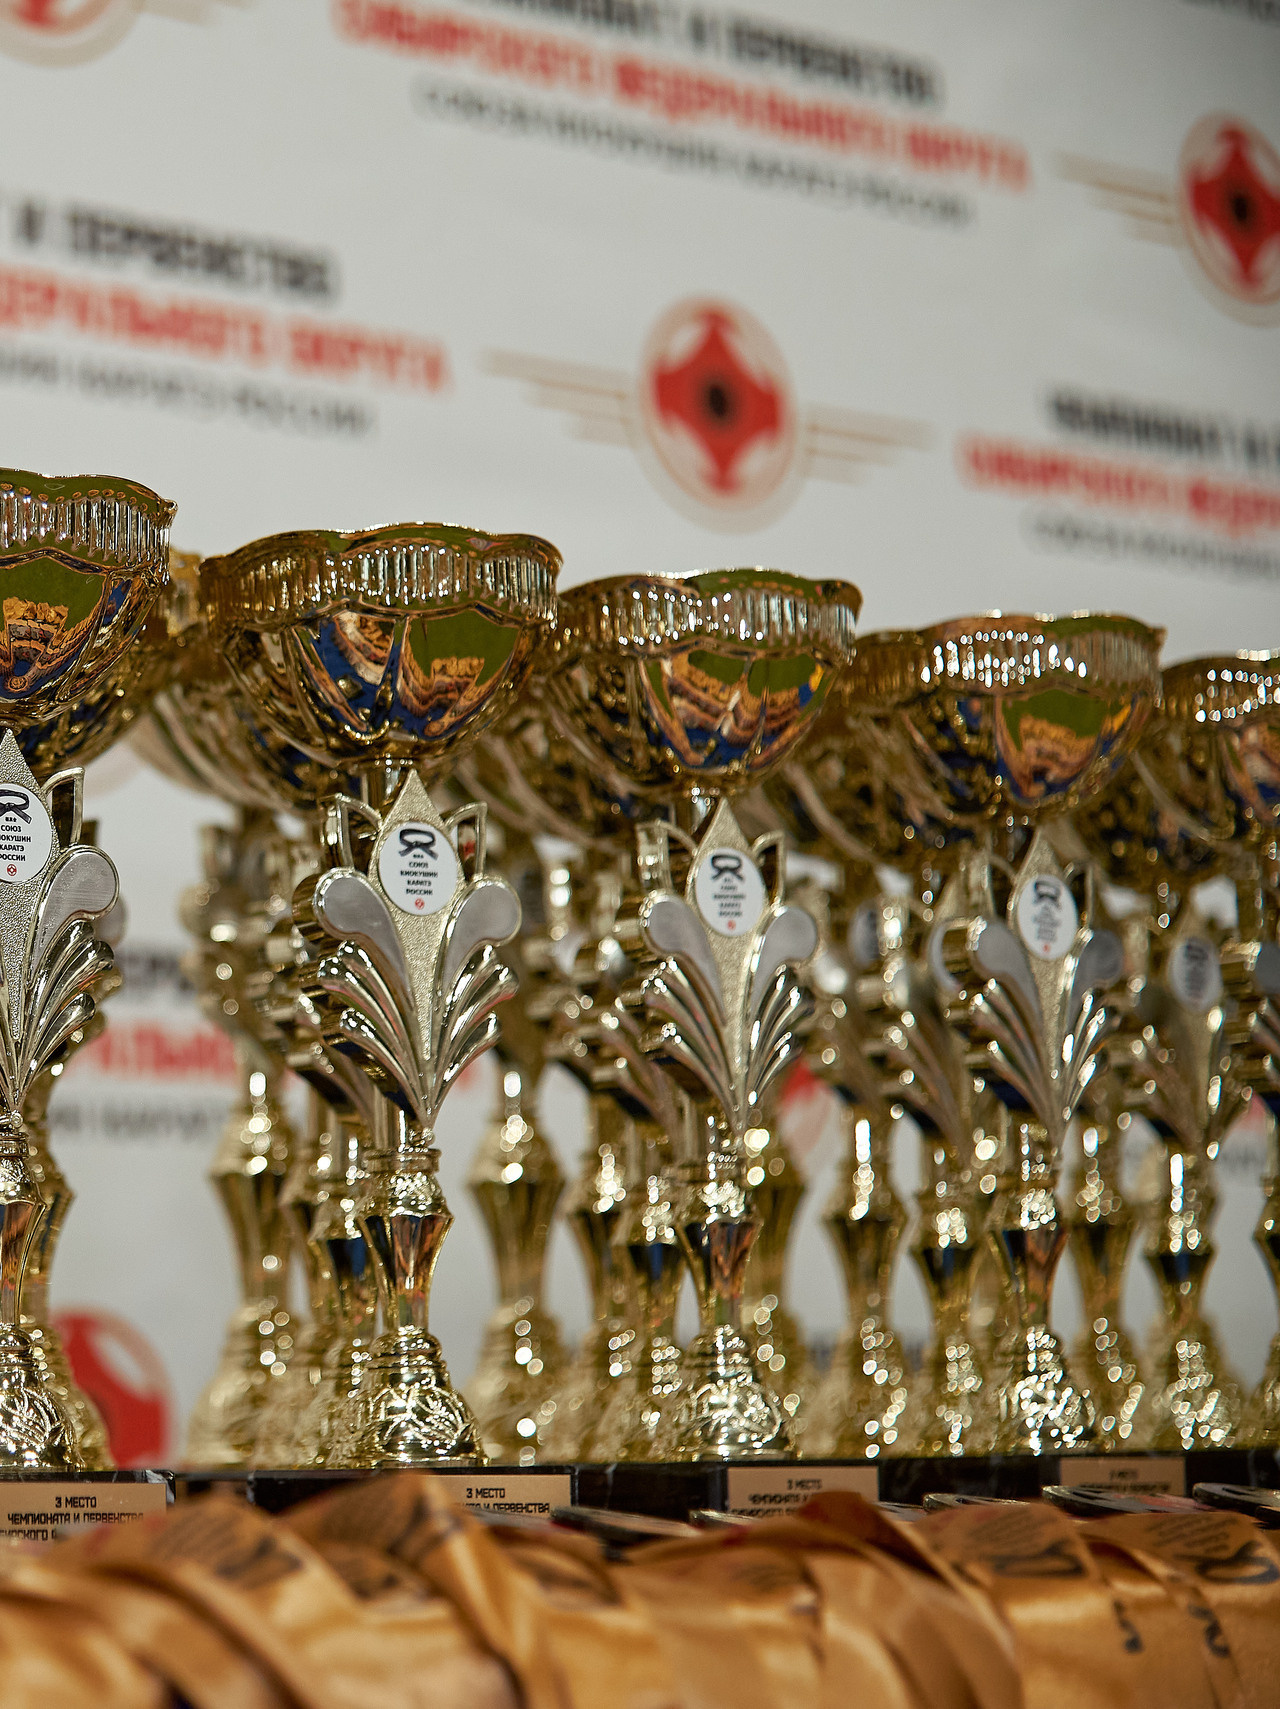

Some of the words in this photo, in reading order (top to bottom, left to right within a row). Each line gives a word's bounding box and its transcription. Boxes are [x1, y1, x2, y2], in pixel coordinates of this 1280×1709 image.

[0, 844, 25, 852] КАРАТЭ
[466, 1488, 473, 1499] 3
[475, 1488, 506, 1499] МЕСТО
[55, 1497, 62, 1508] 3
[65, 1496, 97, 1508] МЕСТО
[7, 1512, 70, 1525] ЧЕМПИОНАТА
[73, 1513, 80, 1524] И
